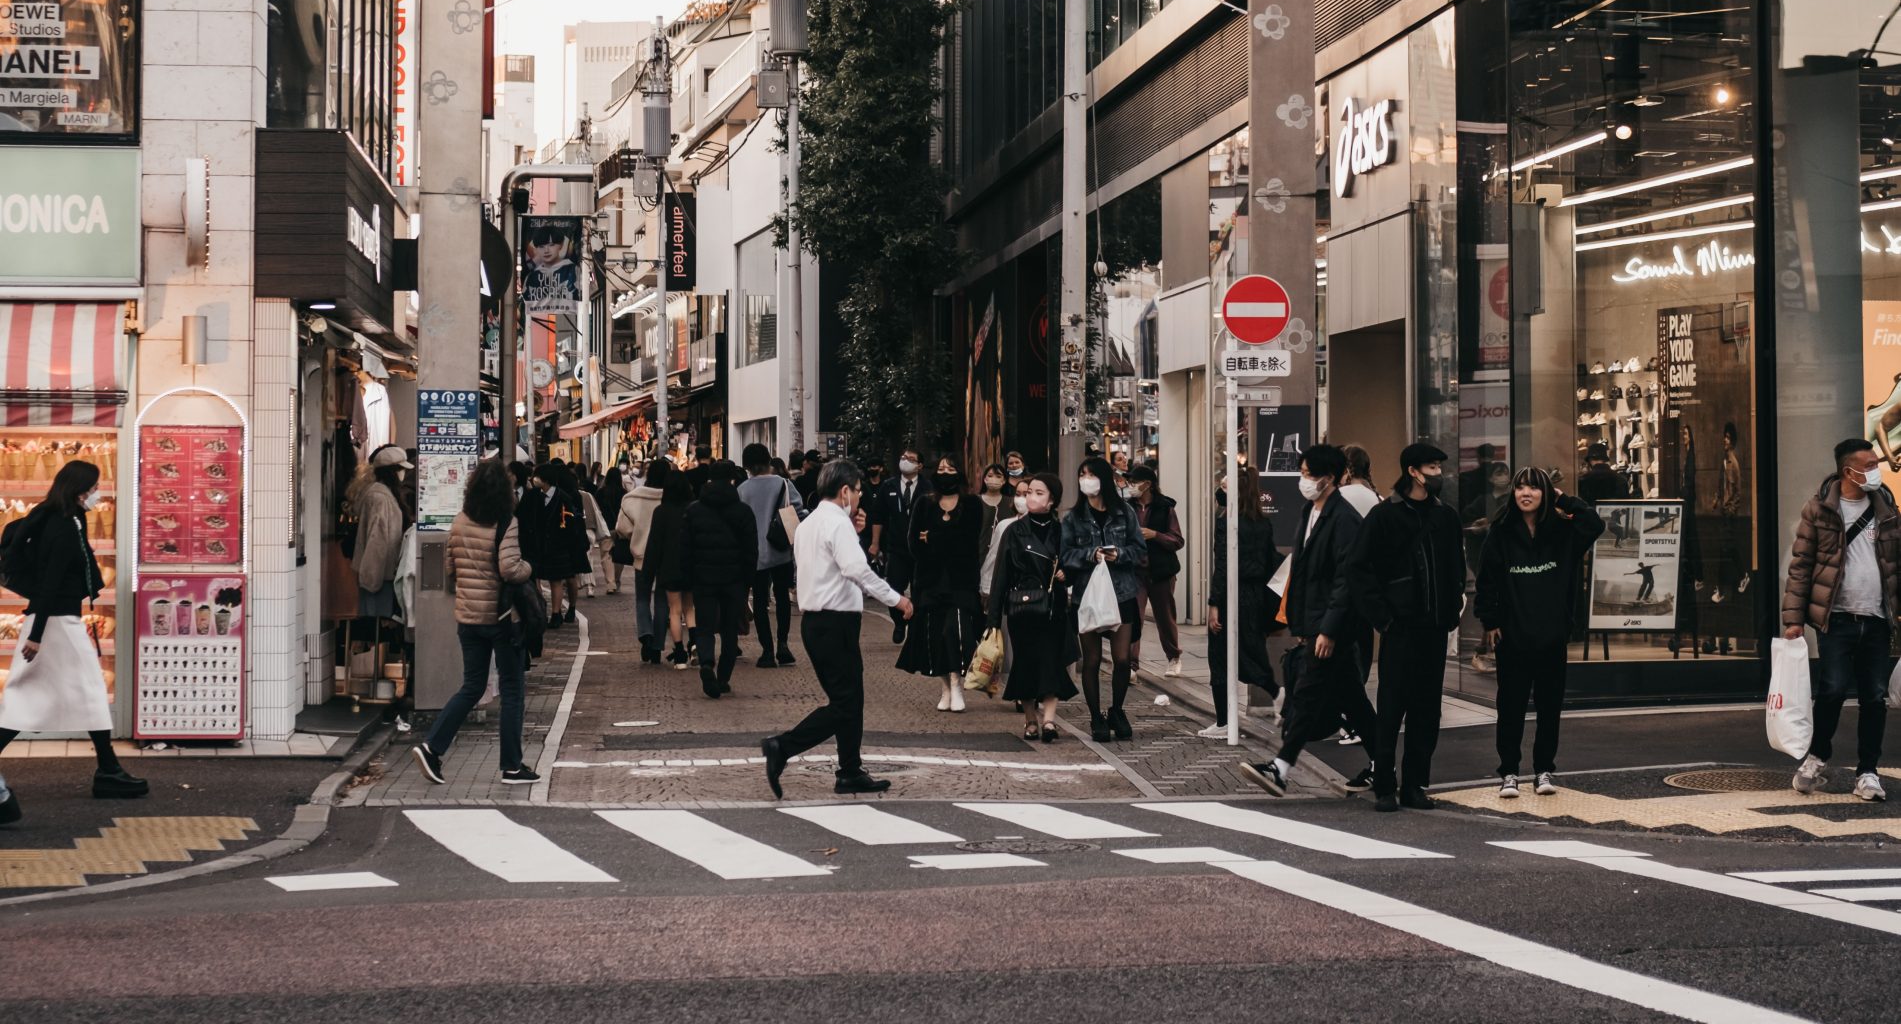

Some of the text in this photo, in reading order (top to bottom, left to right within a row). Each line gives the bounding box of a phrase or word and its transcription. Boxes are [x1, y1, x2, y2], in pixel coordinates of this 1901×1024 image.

[9, 22, 61, 37] Studios
[9, 90, 69, 107] Margiela
[1669, 339, 1694, 363] YOUR
[1226, 357, 1287, 372] 自転車を除く
